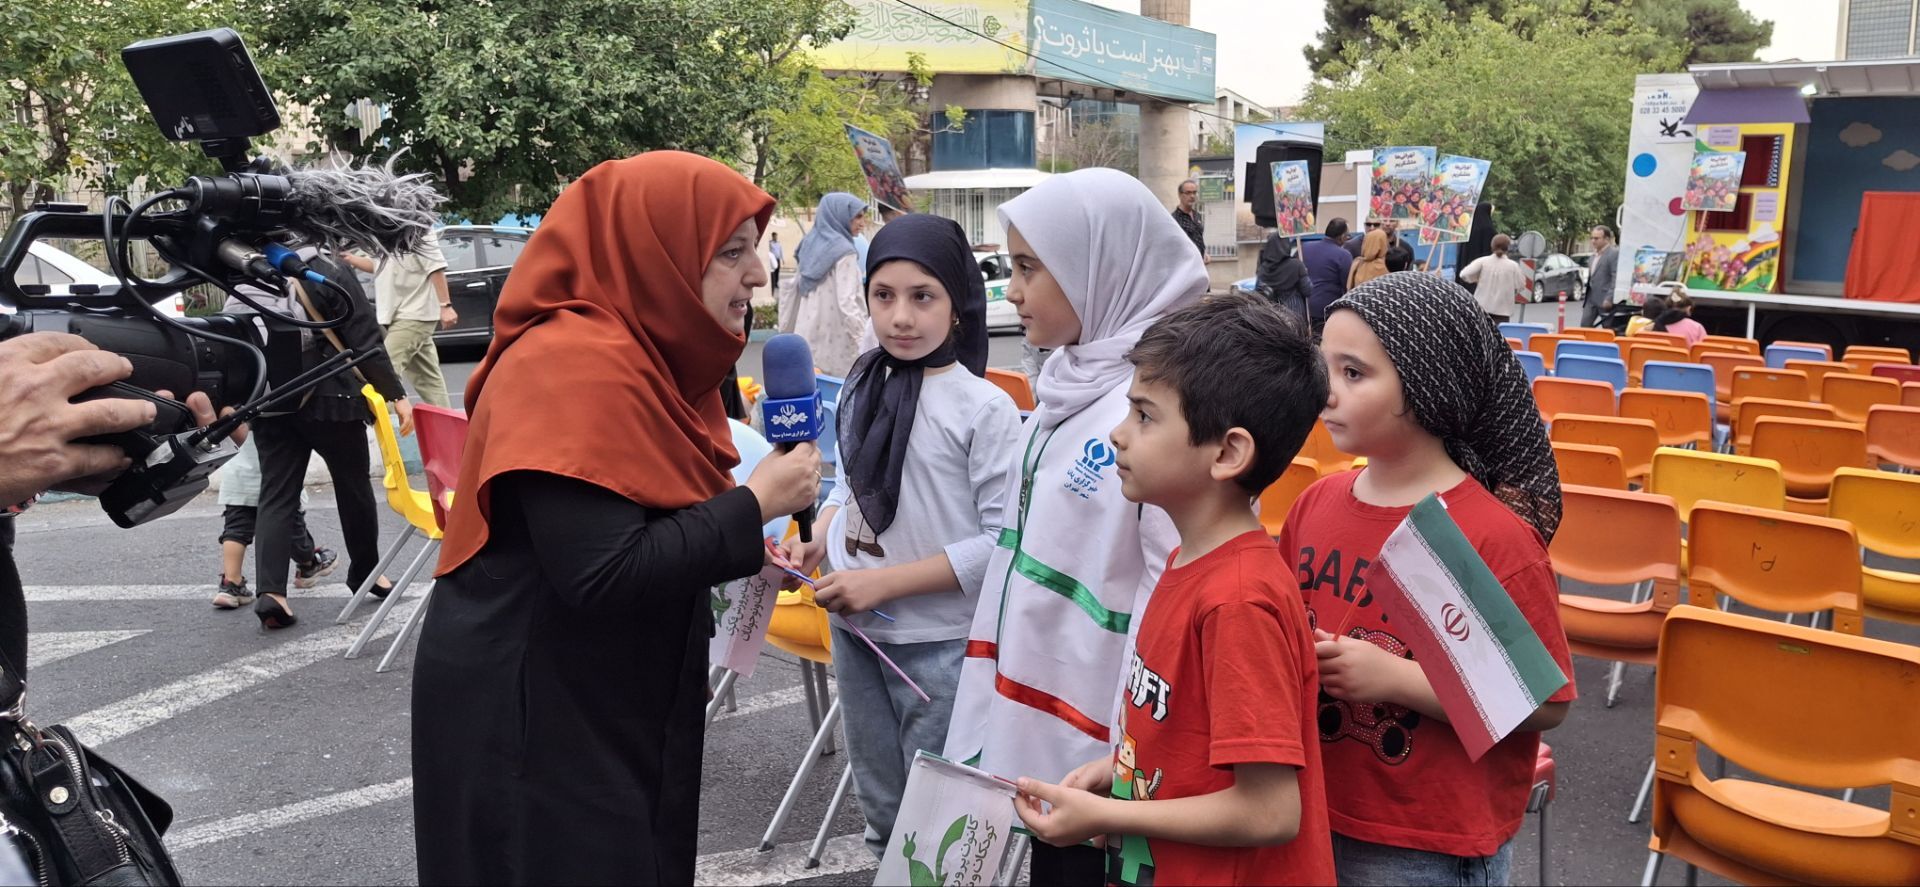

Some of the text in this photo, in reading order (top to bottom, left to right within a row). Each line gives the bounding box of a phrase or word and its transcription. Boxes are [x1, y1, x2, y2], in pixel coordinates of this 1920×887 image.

[1092, 28, 1106, 64] یا
[1106, 40, 1147, 64] است
[1147, 48, 1181, 78] بهتر
[1299, 546, 1379, 612] BAB
[961, 814, 979, 858] کانون
[974, 819, 997, 873] کودکان
